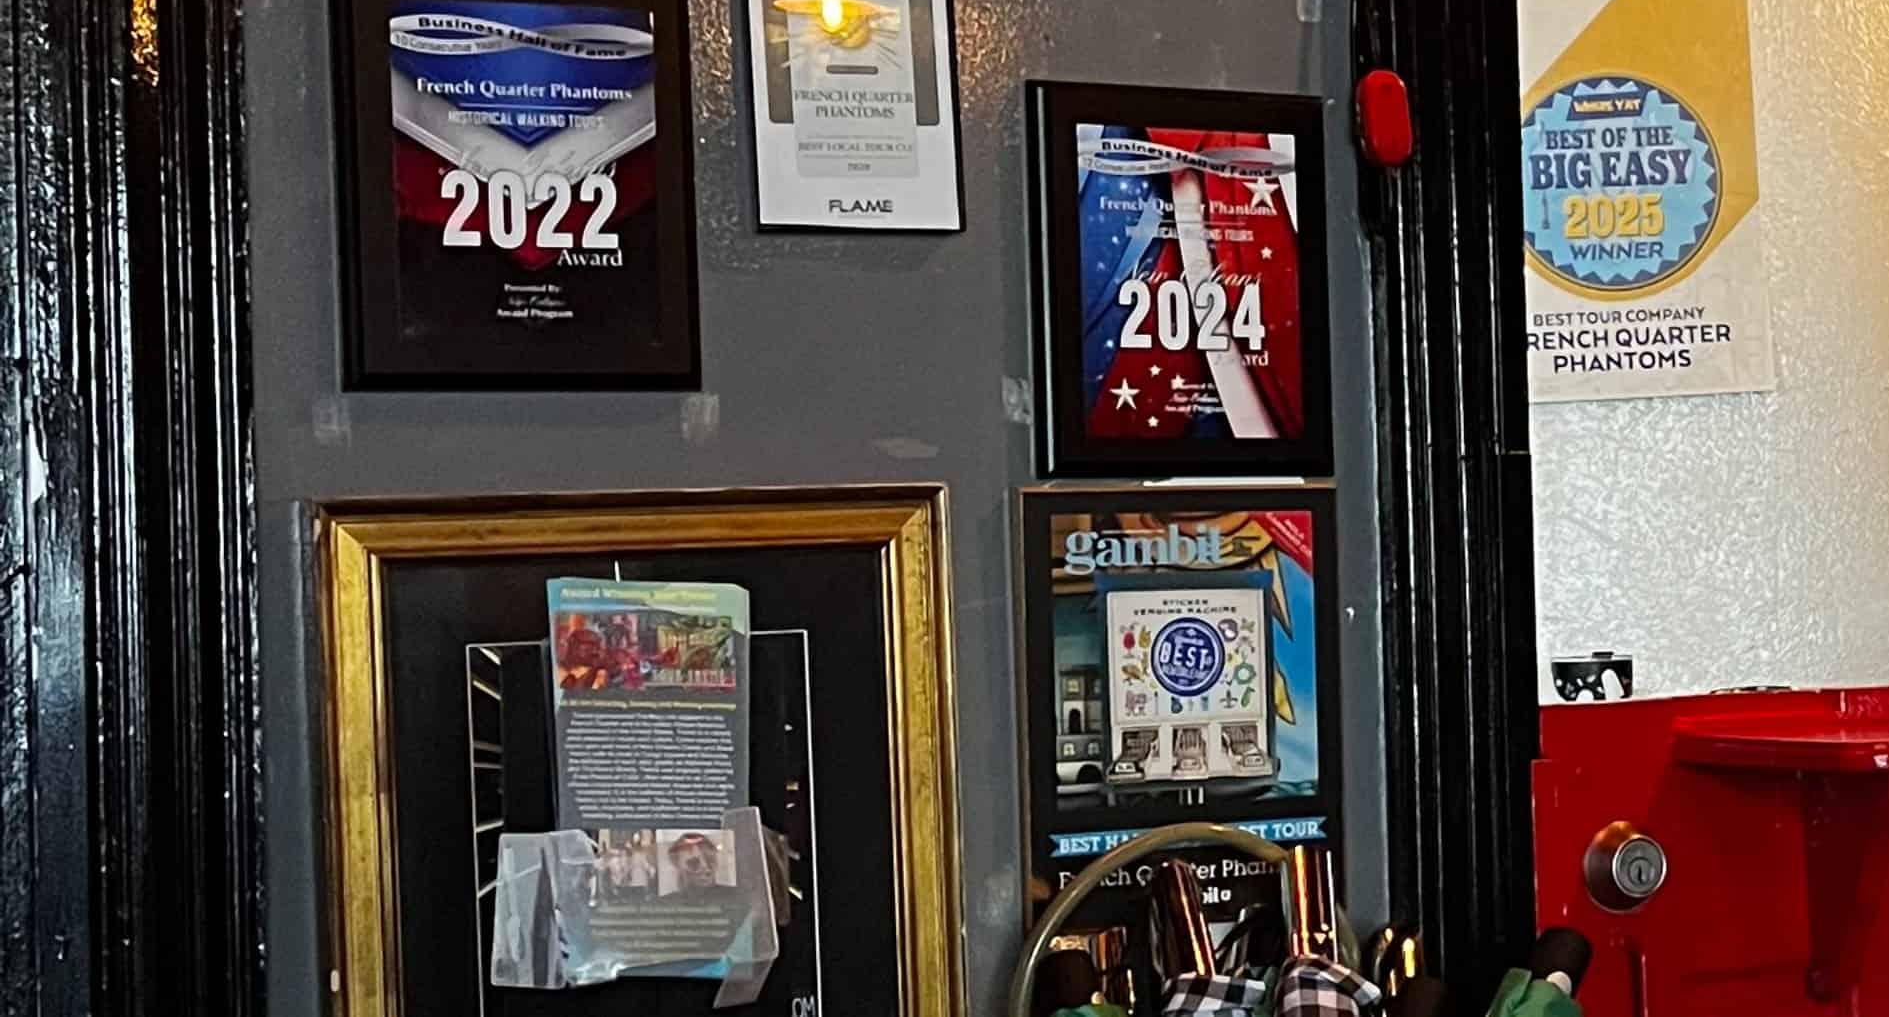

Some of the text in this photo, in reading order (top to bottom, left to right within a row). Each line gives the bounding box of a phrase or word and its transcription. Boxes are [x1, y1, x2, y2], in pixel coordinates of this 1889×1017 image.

[418, 17, 503, 37] Business
[509, 28, 547, 48] Hall
[551, 42, 569, 52] of
[575, 43, 628, 58] Fame
[416, 77, 634, 100] French Quarter Phantoms
[795, 88, 914, 106] FRENCH QUARTER
[517, 111, 567, 128] WALKING
[816, 105, 895, 120] PHANTOMS
[1546, 125, 1673, 150] BEST OF THE
[1101, 141, 1173, 159] Business
[1176, 151, 1209, 169] Hall
[1229, 165, 1272, 178] Fame
[1529, 148, 1693, 191] BIG EASY
[440, 169, 620, 251] 2022
[828, 199, 893, 214] FLAME
[1563, 192, 1665, 239] 2025
[557, 248, 624, 267] Award
[1569, 241, 1665, 261] WINNER
[1119, 279, 1266, 351] 2024
[1534, 307, 1706, 327] BEST TOUR COMPANY
[1527, 323, 1732, 352] RENCH QUARTER
[1553, 349, 1692, 374] PHANTOMS
[1063, 523, 1226, 576] gambit
[1160, 640, 1209, 671] BEST
[1059, 837, 1100, 854] BEST
[1272, 820, 1320, 839] TOUR
